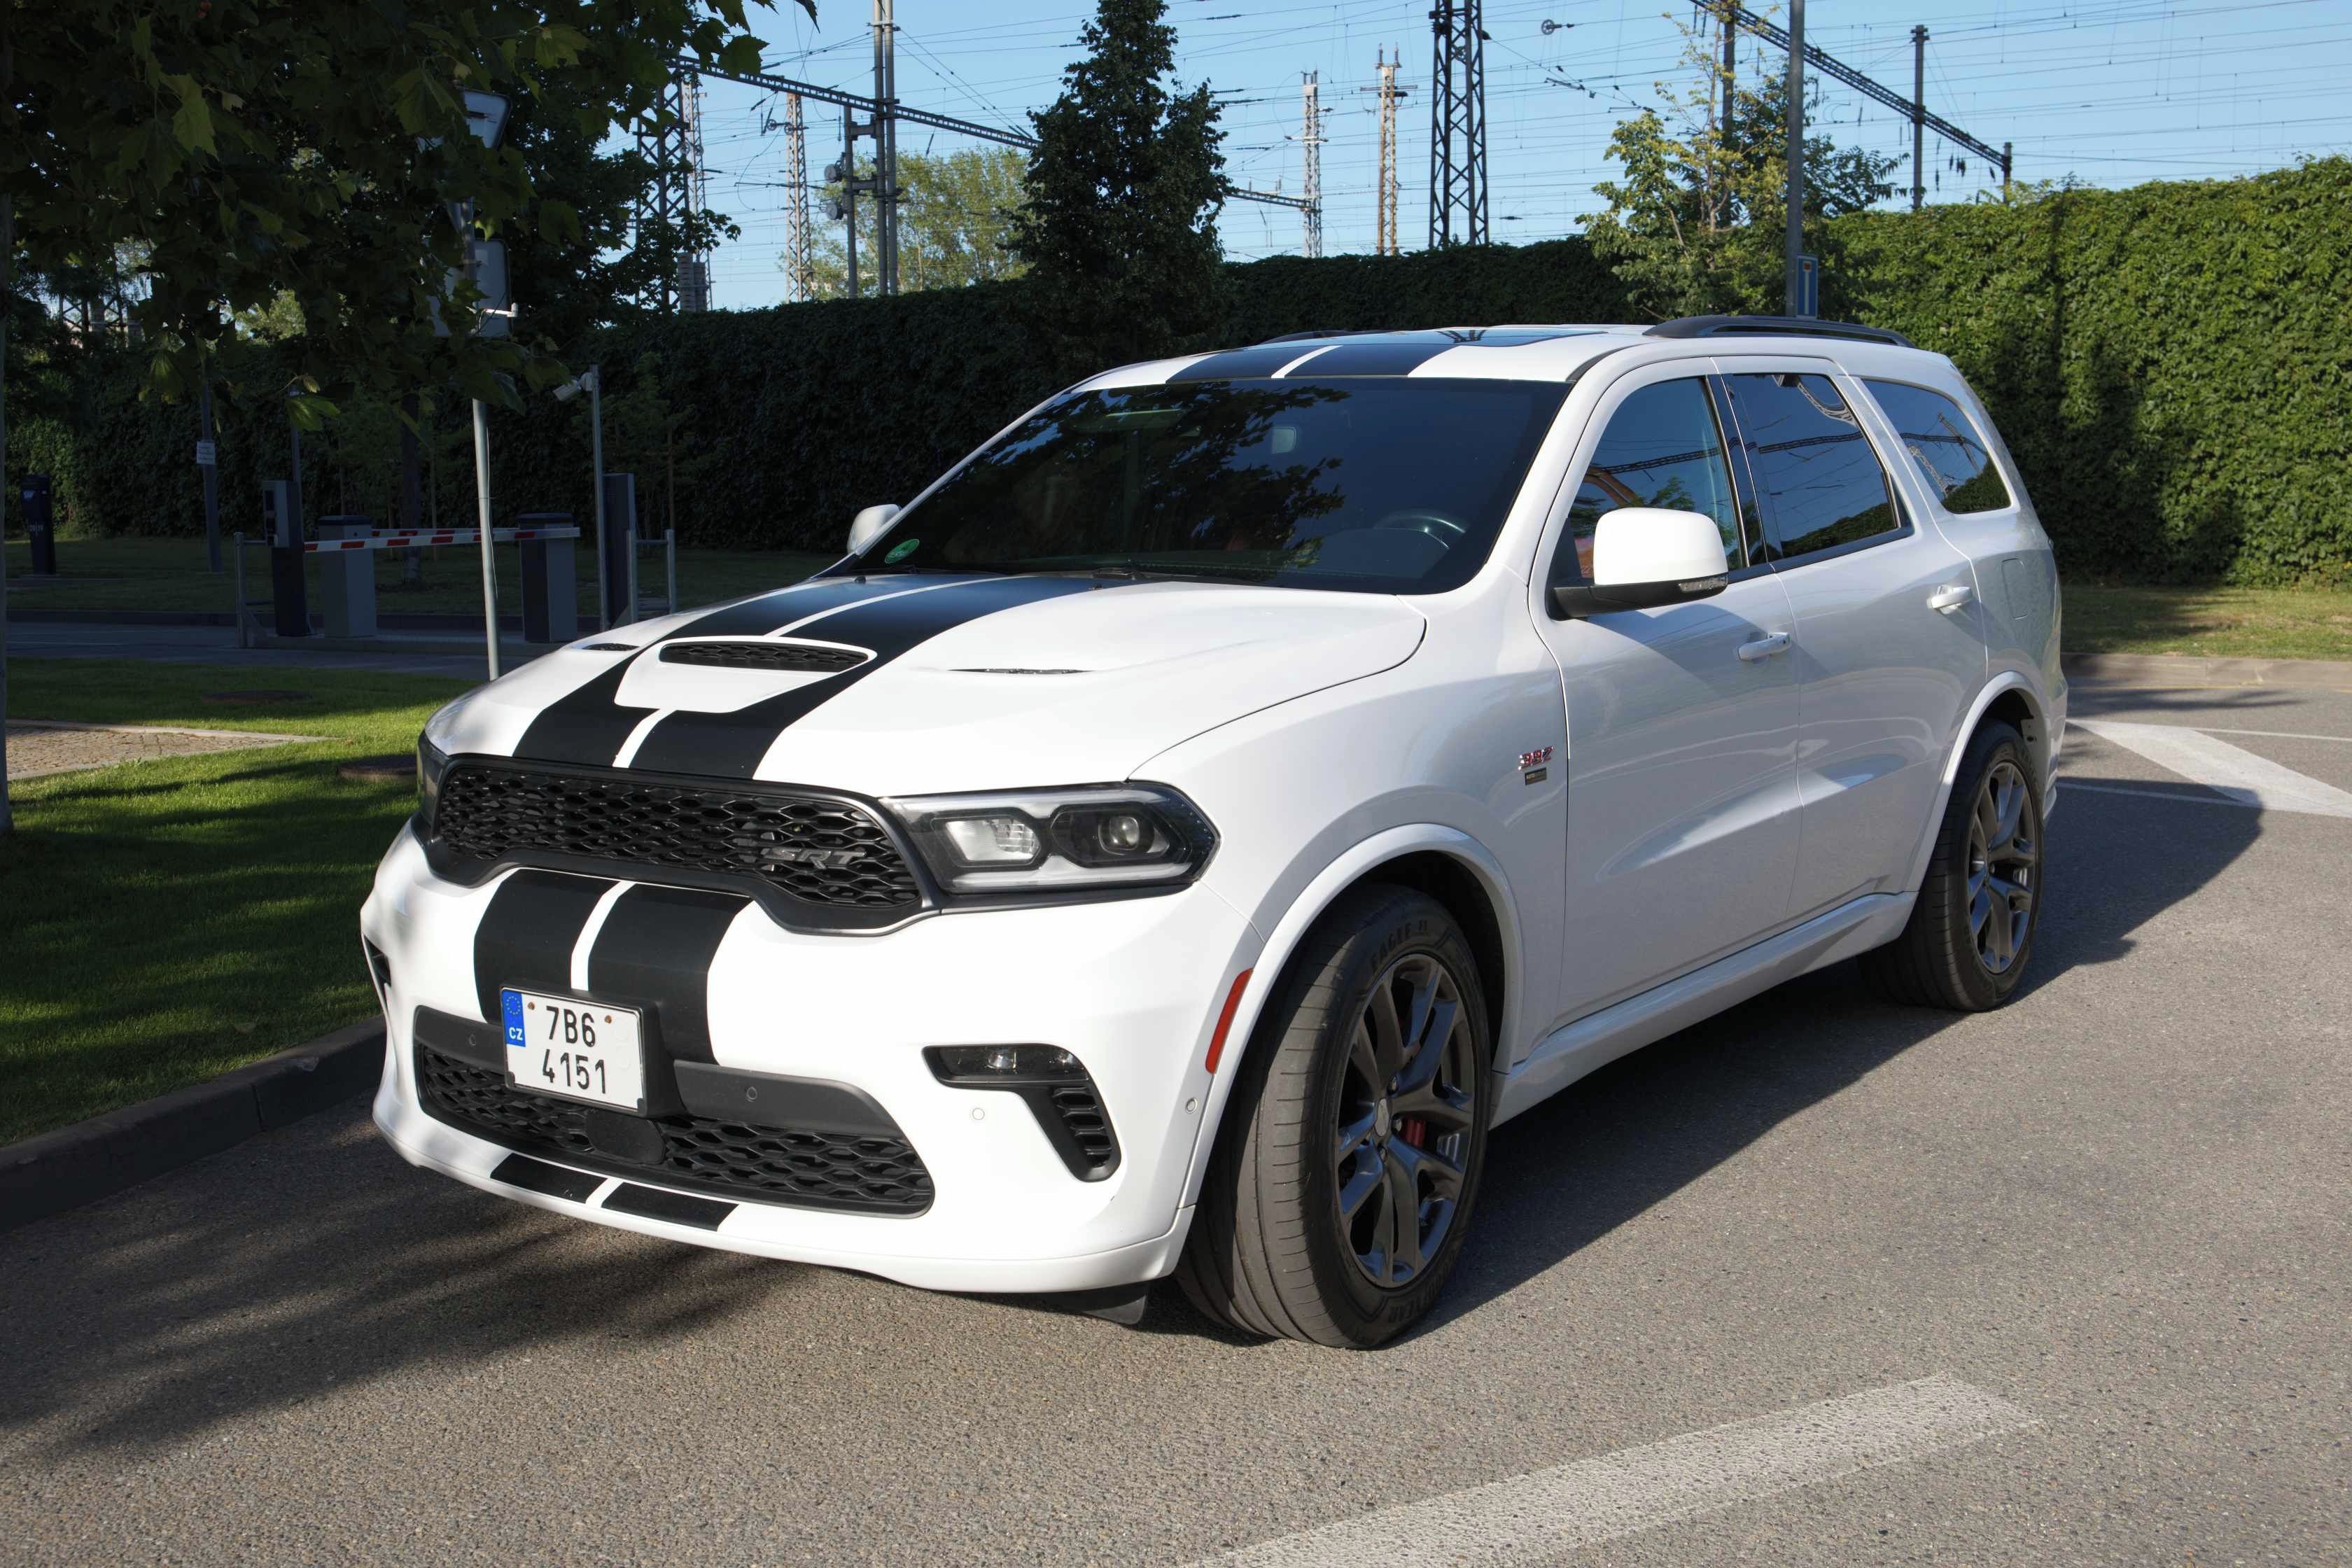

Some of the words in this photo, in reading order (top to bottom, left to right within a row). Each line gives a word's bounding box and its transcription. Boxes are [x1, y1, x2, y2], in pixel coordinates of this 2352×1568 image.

[1518, 745, 1553, 770] 392
[763, 846, 867, 869] SRT
[509, 1027, 524, 1041] CZ
[546, 1005, 596, 1047] 7B6
[542, 1049, 606, 1094] 4151
